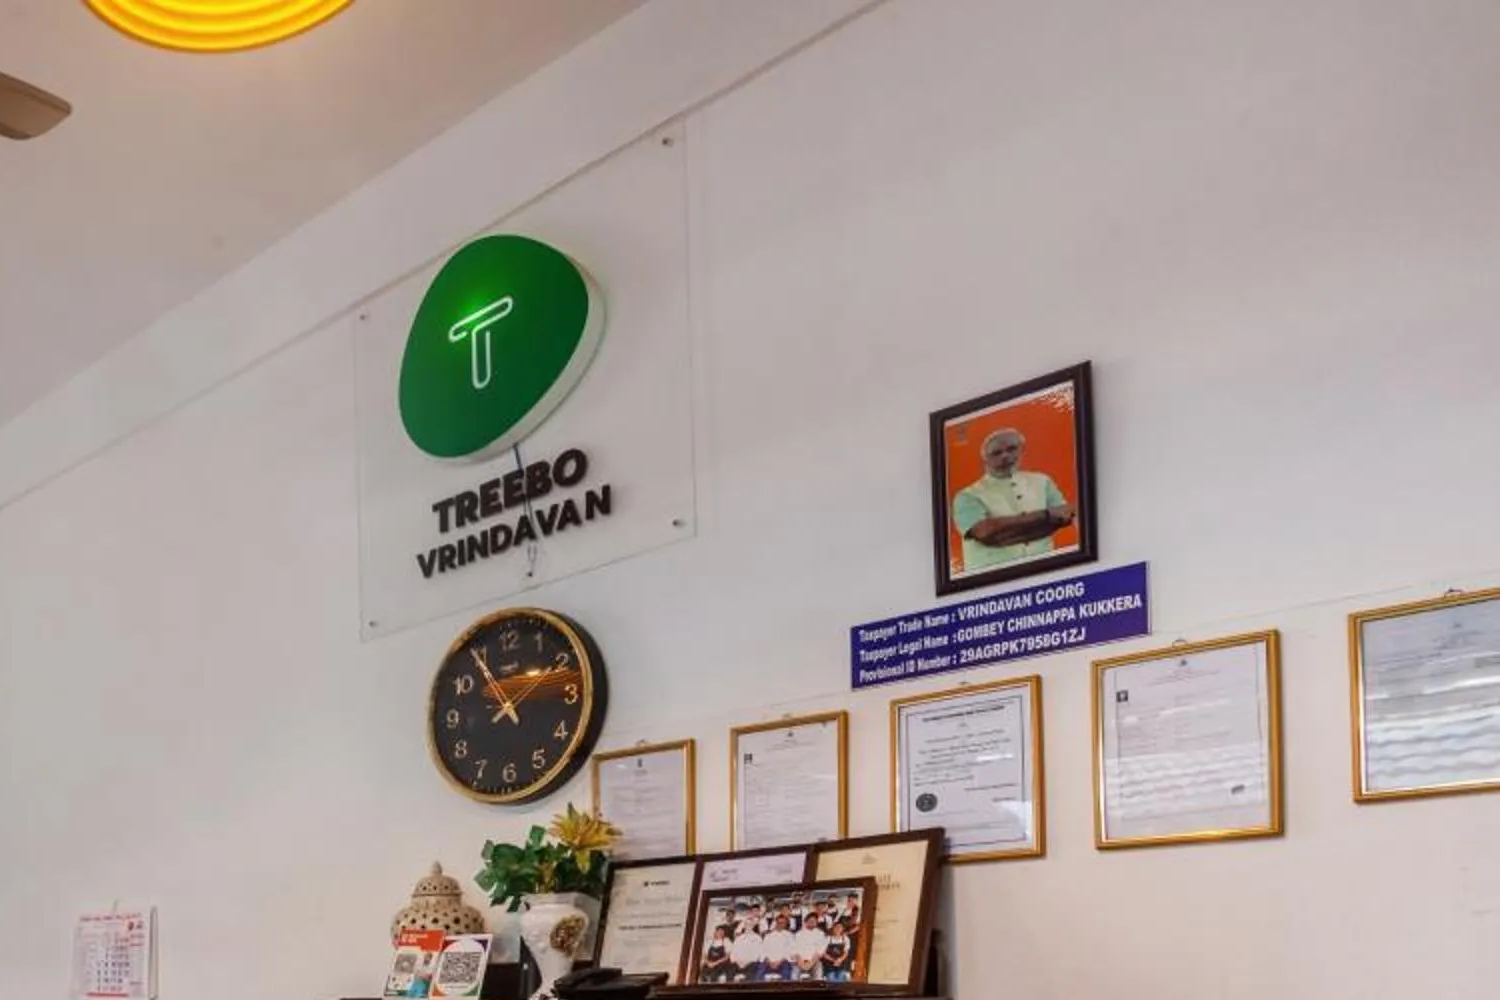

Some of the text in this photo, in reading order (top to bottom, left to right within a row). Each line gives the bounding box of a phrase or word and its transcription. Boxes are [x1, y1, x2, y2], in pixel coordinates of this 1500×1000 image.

[431, 448, 588, 533] TREEBO
[417, 485, 612, 579] VRINDAVAN
[898, 618, 922, 633] Trade
[924, 614, 949, 628] Name
[958, 593, 1031, 620] VRINDAVAN
[1036, 582, 1086, 604] COORG
[899, 638, 922, 655] Legal
[924, 635, 948, 648] Name
[1007, 608, 1075, 632] CHINNAPPA
[1079, 594, 1142, 618] KUKKERA
[500, 630, 519, 650] 12
[534, 632, 543, 651] 1
[555, 653, 569, 672] 2
[918, 656, 950, 671] Number
[453, 675, 474, 695] 10
[564, 684, 578, 705] 3
[446, 710, 460, 728] 9
[554, 720, 568, 740] 4
[454, 740, 467, 758] 8
[532, 748, 546, 769] 5
[474, 759, 487, 779] 7
[502, 764, 517, 782] 6
